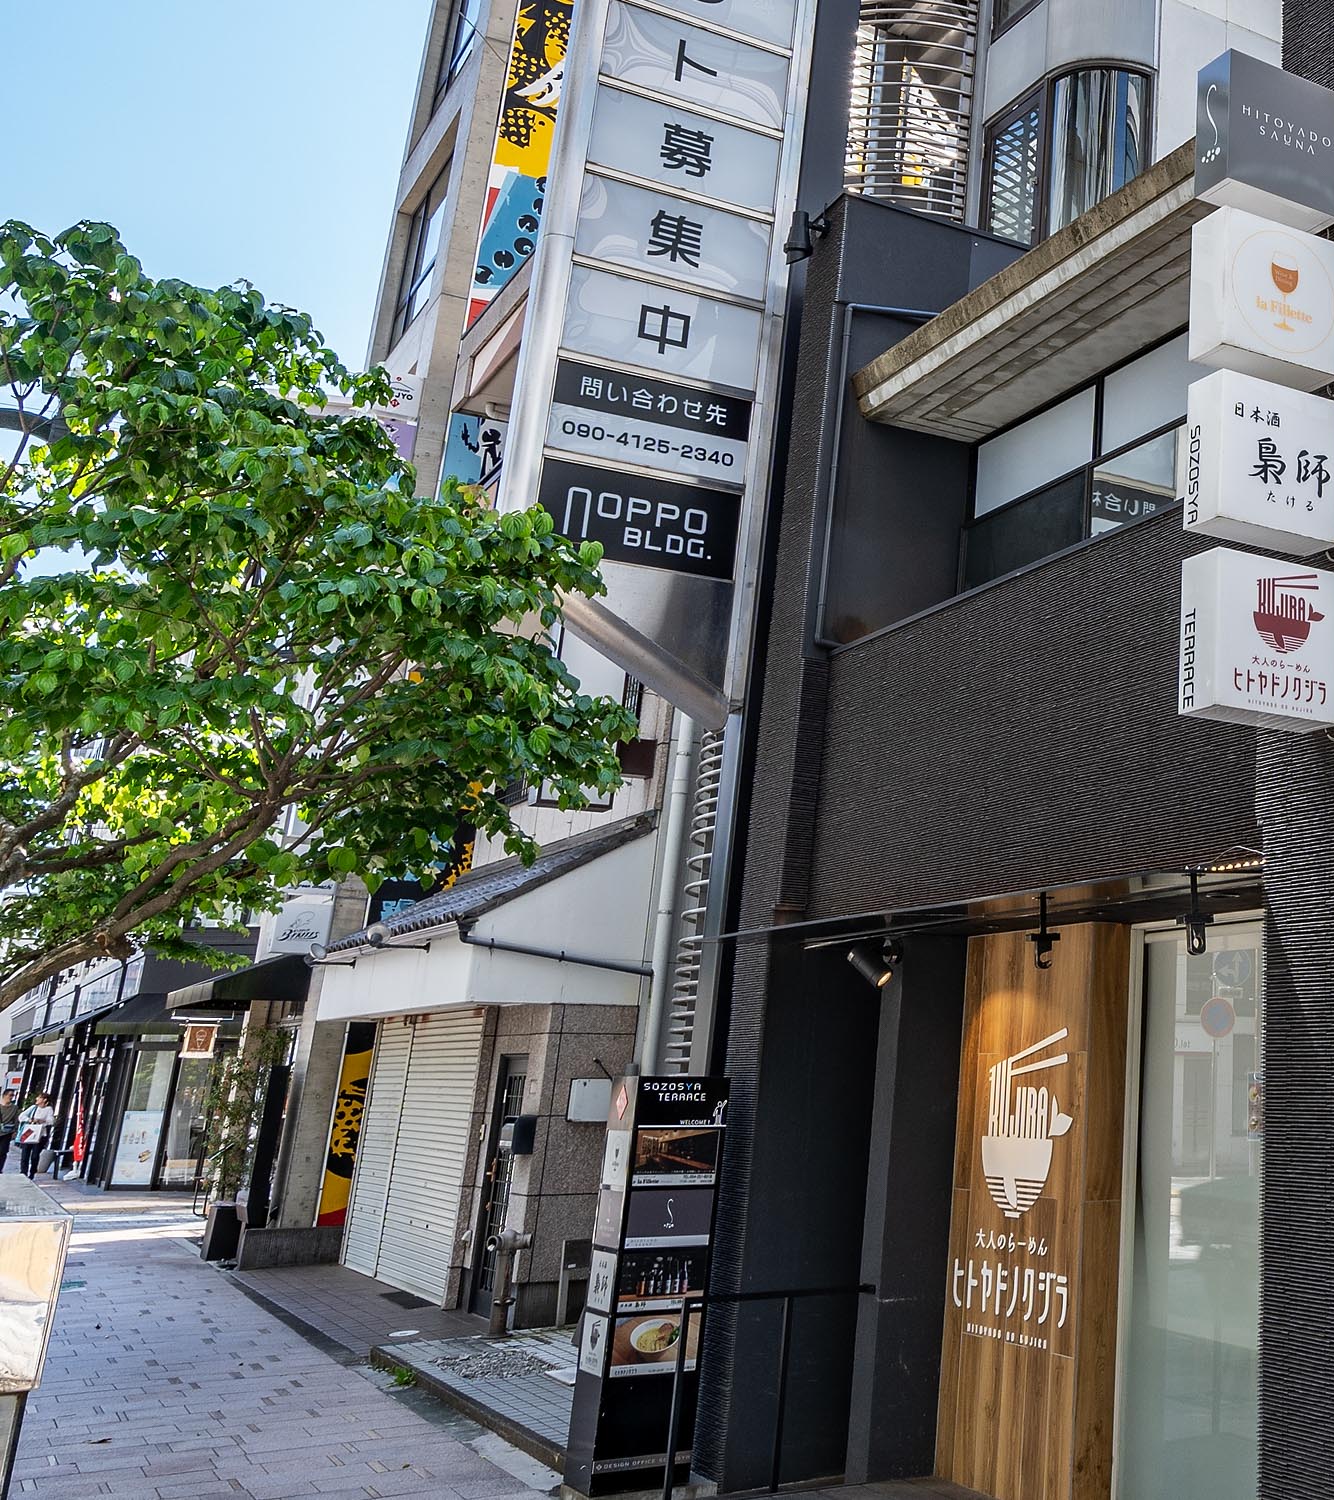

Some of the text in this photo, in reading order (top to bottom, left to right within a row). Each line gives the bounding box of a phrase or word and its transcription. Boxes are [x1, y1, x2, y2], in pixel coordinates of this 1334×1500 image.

[1242, 104, 1331, 147] HITOYADO
[1260, 125, 1315, 155] SAUNA
[637, 0, 722, 354] ト募集中
[580, 376, 728, 426] 問い合わせ先
[1234, 401, 1281, 429] 日本酒
[562, 420, 734, 467] 090-4125-2340
[1187, 424, 1201, 526] SOZOSYA
[1266, 490, 1315, 512] たける
[623, 526, 712, 560] BLDG.
[1182, 608, 1196, 710] TERRACE
[1252, 655, 1311, 674] 大人のらーめん
[1234, 667, 1327, 705] ヒトヤドノクジラ
[643, 1082, 702, 1091] SOZOSYA
[658, 1092, 707, 1102] TERRACE
[975, 1228, 1048, 1256] 大人のらーめん
[953, 1258, 1067, 1328] ヒトヤドノクジラ
